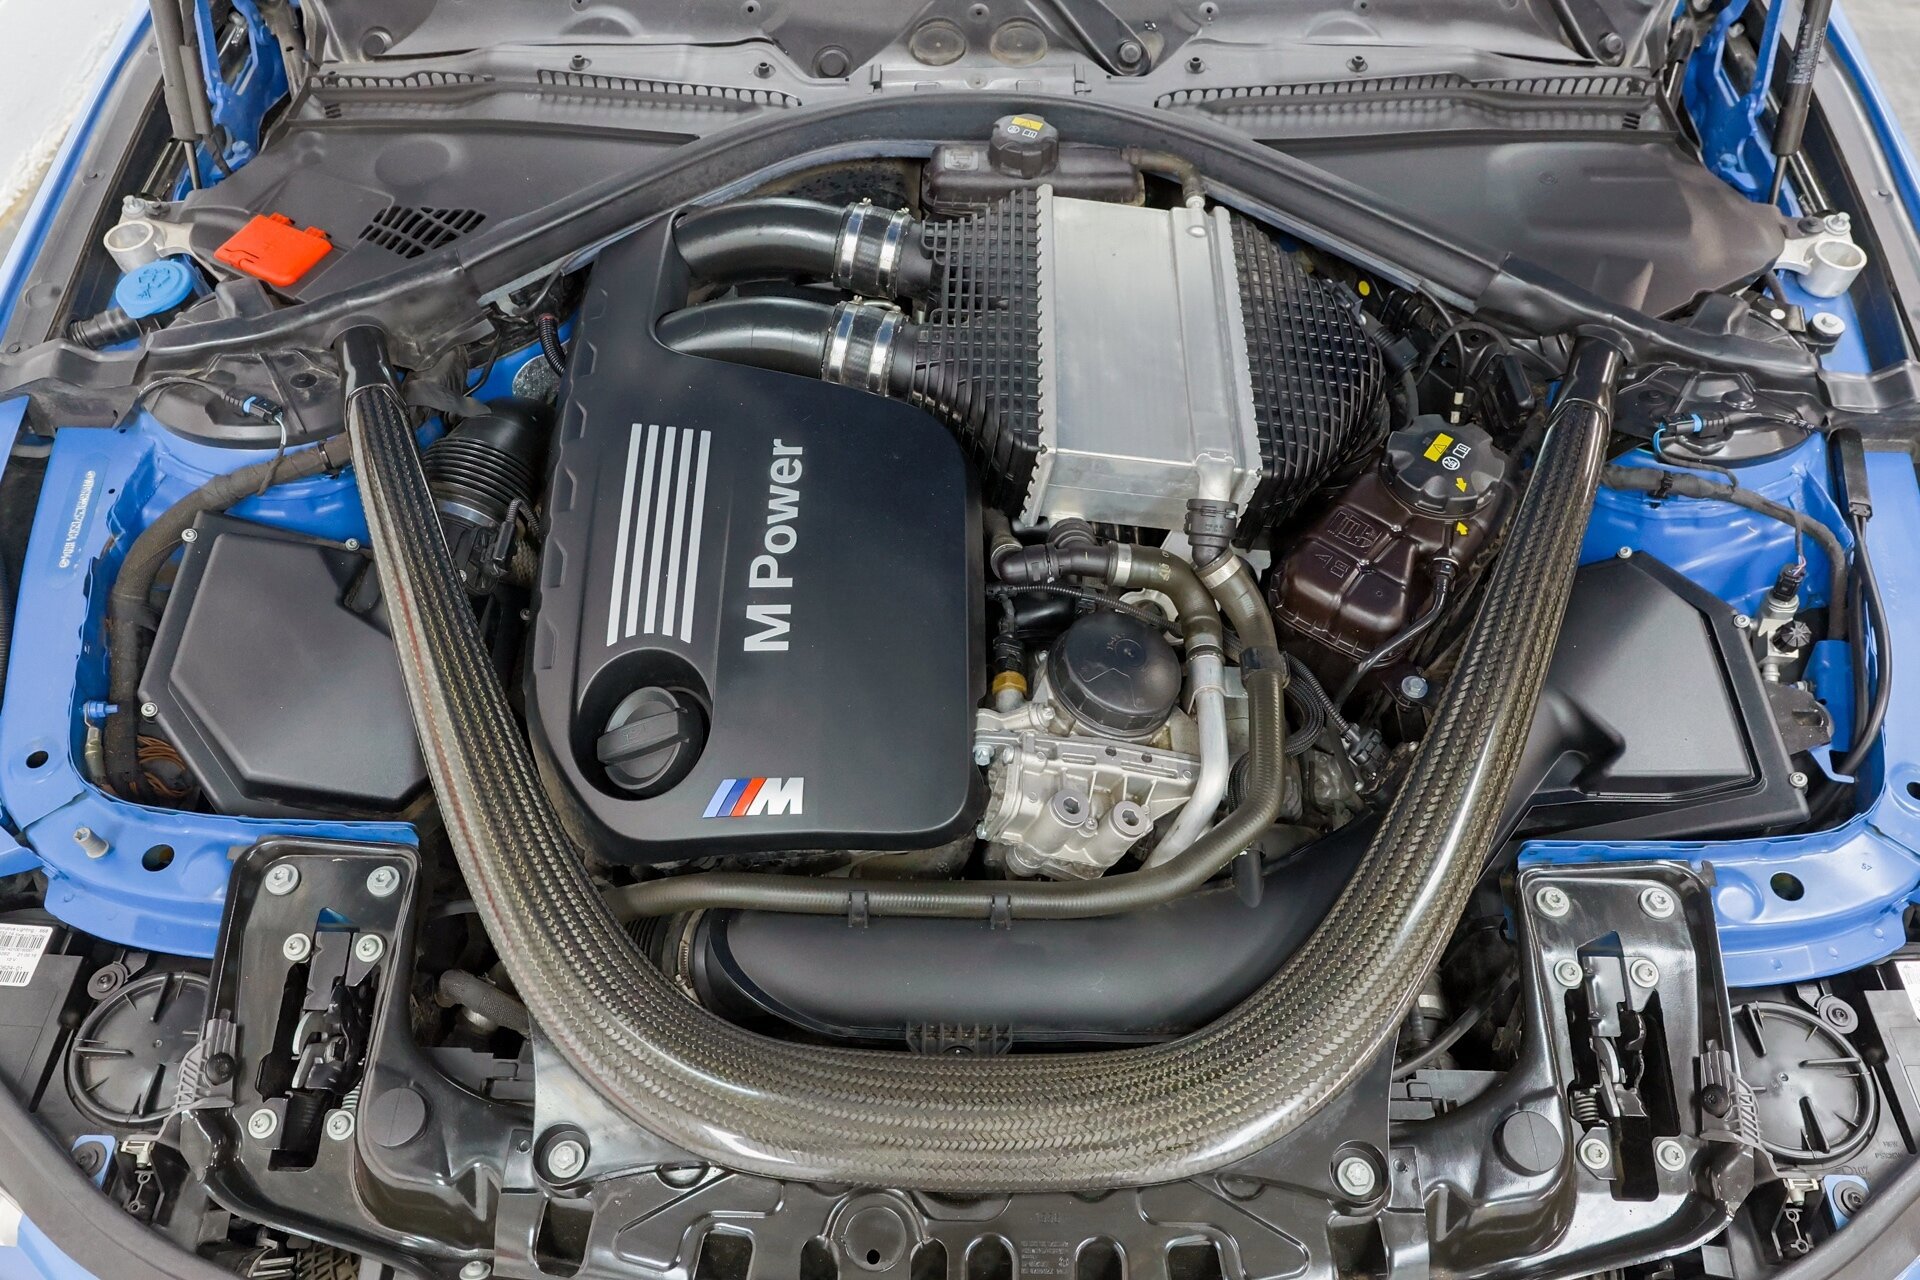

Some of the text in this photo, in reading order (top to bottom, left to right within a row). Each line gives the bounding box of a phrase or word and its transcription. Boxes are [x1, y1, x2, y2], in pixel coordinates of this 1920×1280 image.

[743, 438, 804, 652] M Power
[745, 776, 804, 816] M
